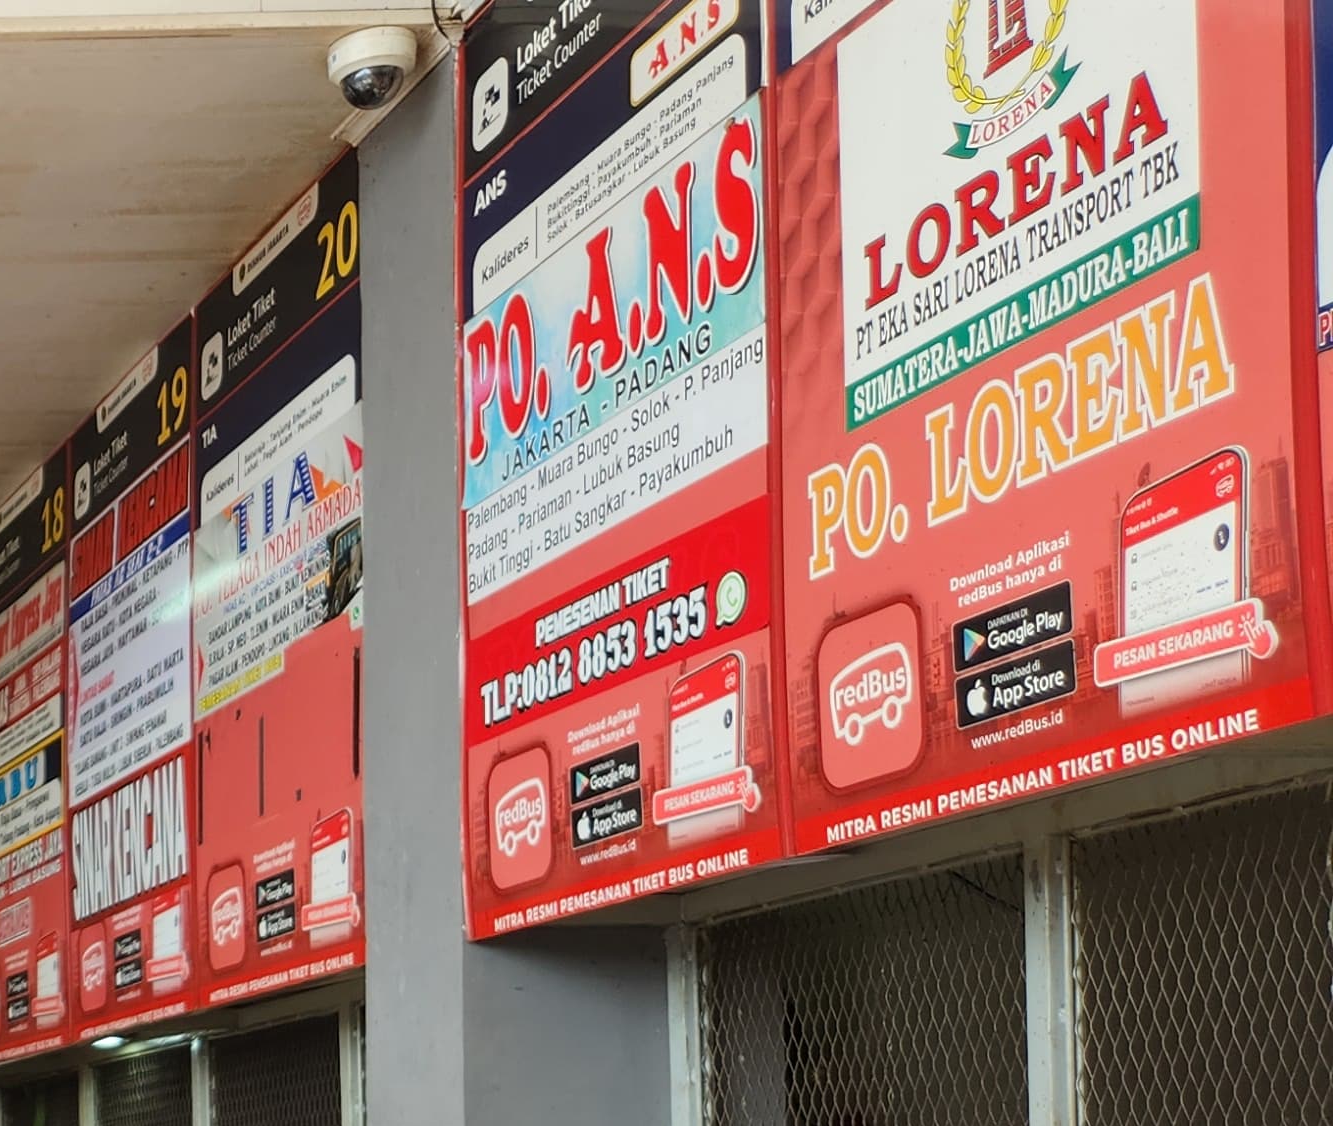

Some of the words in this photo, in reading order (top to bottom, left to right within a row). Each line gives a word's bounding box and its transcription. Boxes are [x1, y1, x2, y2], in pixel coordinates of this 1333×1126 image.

[516, 24, 556, 72] Loket
[516, 59, 553, 105] Ticket
[553, 12, 602, 69] Counter
[546, 168, 590, 215] Palembang
[596, 147, 622, 171] Muara
[624, 122, 652, 152] Bungo
[660, 88, 693, 120] Padang
[695, 54, 734, 94] Panjang
[968, 79, 1054, 146] LORENA
[473, 169, 508, 217] ANS
[546, 181, 592, 229] Bukittinggi
[596, 137, 652, 188] Payakumbuh
[659, 97, 702, 138] Pariaman
[546, 220, 568, 243] Solok
[574, 171, 626, 221] Batusangkar
[632, 145, 661, 173] Lubuk
[663, 116, 697, 150] Basung
[863, 70, 1169, 312] LORENA
[316, 200, 359, 301] 20
[481, 234, 530, 285] Kalideres
[855, 325, 874, 361] PT
[879, 307, 910, 350] EKA
[913, 283, 950, 328] SARI
[954, 248, 1022, 308] LORENA
[1025, 172, 1134, 276] TRANSPORT
[1139, 141, 1182, 200] TBK
[227, 313, 252, 348] Loket
[252, 287, 277, 322] Tiket
[464, 292, 552, 466] PO.
[565, 116, 758, 395] A.N.S
[227, 340, 249, 371] Ticket
[249, 315, 277, 352] Counter
[156, 366, 187, 447] 19
[467, 483, 528, 534] Palembang
[538, 452, 574, 491] Muara
[577, 428, 618, 466] Bungo
[631, 391, 671, 432] Solok
[684, 375, 697, 401] P.
[701, 337, 765, 391] Panjang
[502, 402, 591, 481] JAKARTA
[614, 323, 712, 408] PADANG
[808, 443, 910, 580] PO.
[925, 272, 1235, 528] LORENA
[111, 431, 128, 455] Tiket
[201, 424, 218, 449] TIA
[41, 486, 64, 554] 18
[205, 472, 235, 504] Kalideres
[230, 450, 317, 559] TIA
[467, 528, 509, 563] Padang
[517, 490, 573, 531] Pariaman
[582, 455, 624, 495] Lubuk
[626, 422, 681, 470] Basung
[468, 565, 497, 594] Bukit
[498, 543, 534, 582] Tinggi
[543, 521, 572, 552] Batu
[574, 488, 627, 533] Sangkar
[638, 425, 735, 497] Payakumbuh
[264, 521, 301, 572] INDAH
[306, 477, 362, 543] ARMADA
[949, 554, 1013, 592] Download
[1015, 530, 1071, 574] Aplikasi
[957, 579, 1002, 608] redBus
[1004, 563, 1046, 598] hanya
[1048, 557, 1063, 575] di
[534, 579, 622, 648] PEMESENAN
[622, 556, 671, 605] TIKET
[987, 620, 1035, 651] Google
[1035, 607, 1065, 639] Play
[481, 646, 573, 727] TLP:0812
[577, 618, 638, 686] 8853
[644, 582, 707, 659] 1535
[991, 665, 1031, 687] Download
[1030, 659, 1042, 674] di
[1113, 640, 1156, 670] PESAN
[1157, 619, 1234, 657] SEKARANG
[834, 666, 908, 712] redBus
[992, 683, 1023, 713] App
[1023, 668, 1065, 700] Store
[567, 714, 607, 744] Download
[608, 702, 641, 728] Aplikasi
[970, 710, 1064, 751] www.redBus.id
[589, 768, 618, 792] Google
[618, 761, 637, 786] Play
[825, 815, 877, 844] MITRA
[880, 800, 933, 830] RESMI
[936, 767, 1053, 816] PEMESANAN
[1057, 748, 1115, 782] TIKET
[1121, 737, 1165, 767] BUS
[1171, 708, 1261, 751] ONLINE
[72, 796, 112, 923] SINAR
[112, 754, 188, 905] KENCANA
[498, 794, 542, 826] redBus
[593, 815, 613, 835] App
[612, 807, 638, 829] Store
[579, 839, 637, 866] www.redBus.id
[493, 908, 524, 933] MITRA
[526, 899, 558, 924] RESMI
[560, 883, 631, 916] PEMESANAN
[633, 873, 666, 896] TIKET
[668, 863, 695, 885] BUS
[697, 848, 749, 878] ONLINE
[310, 960, 326, 975] BUS
[326, 951, 354, 971] ONLINE
